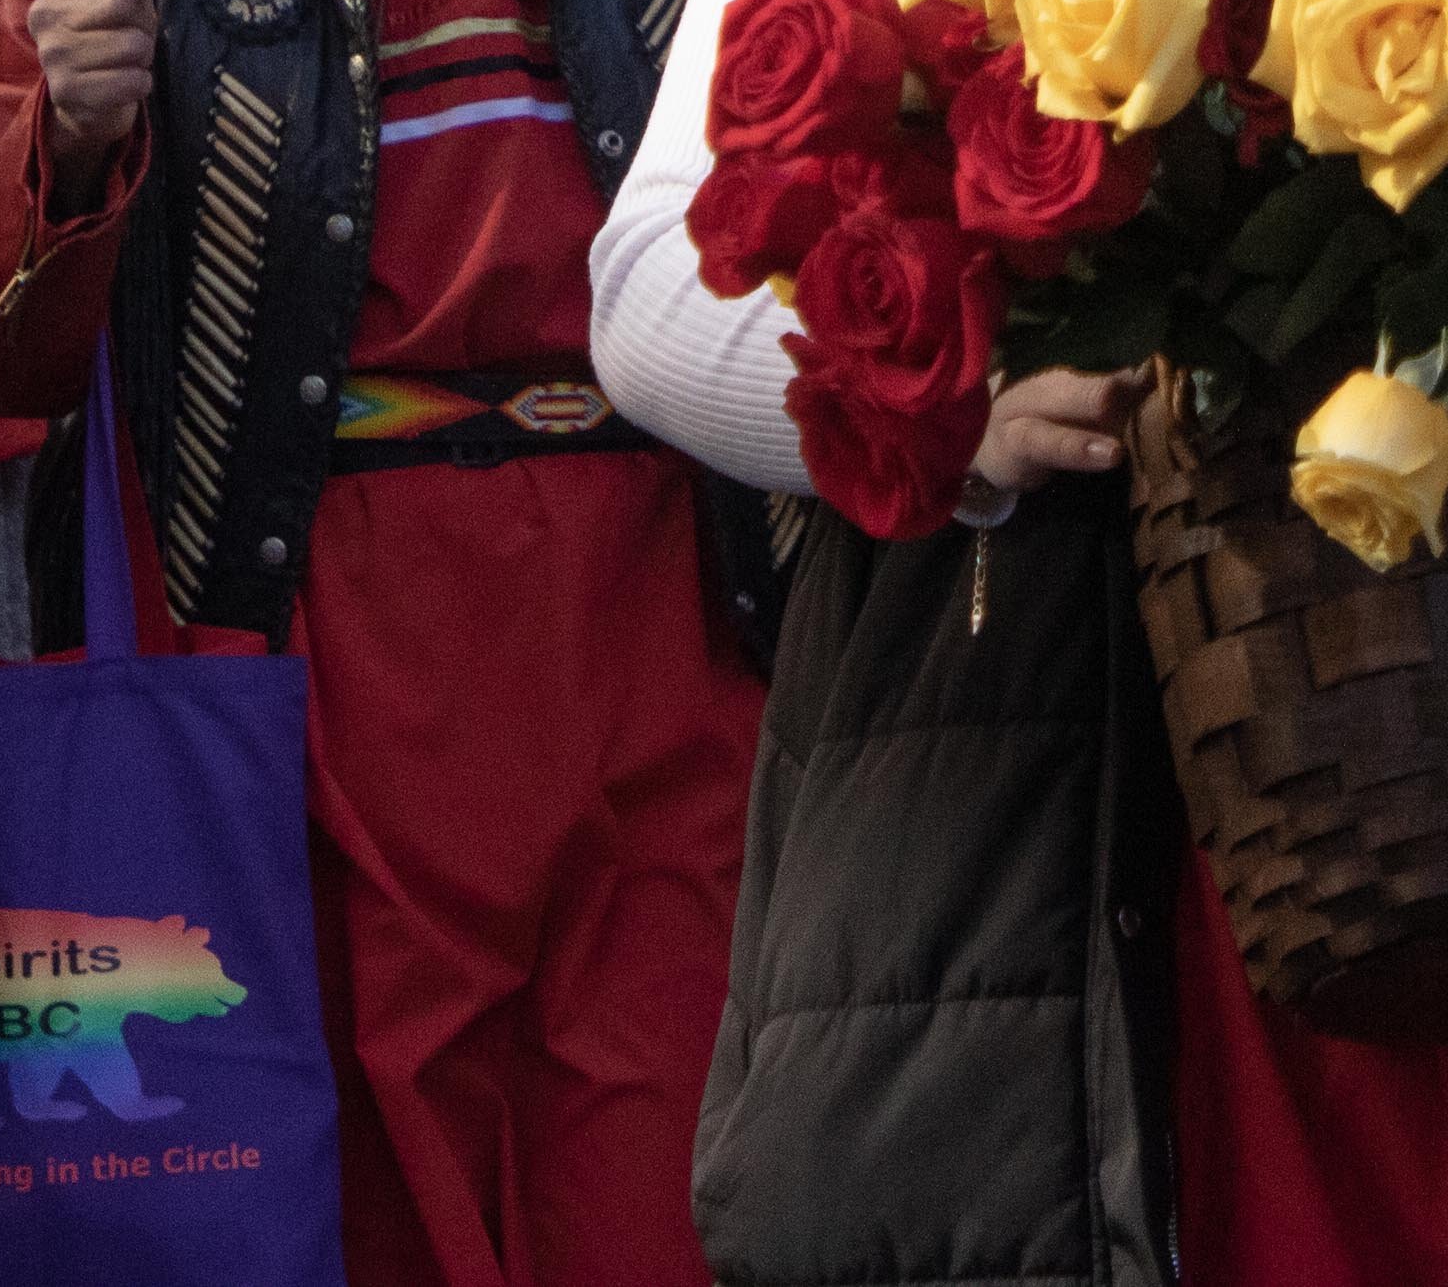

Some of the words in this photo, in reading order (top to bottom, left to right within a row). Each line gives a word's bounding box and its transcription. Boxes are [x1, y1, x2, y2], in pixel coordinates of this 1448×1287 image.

[46, 1156, 79, 1184] in
[92, 1151, 151, 1181] the
[162, 1142, 262, 1175] Circle
